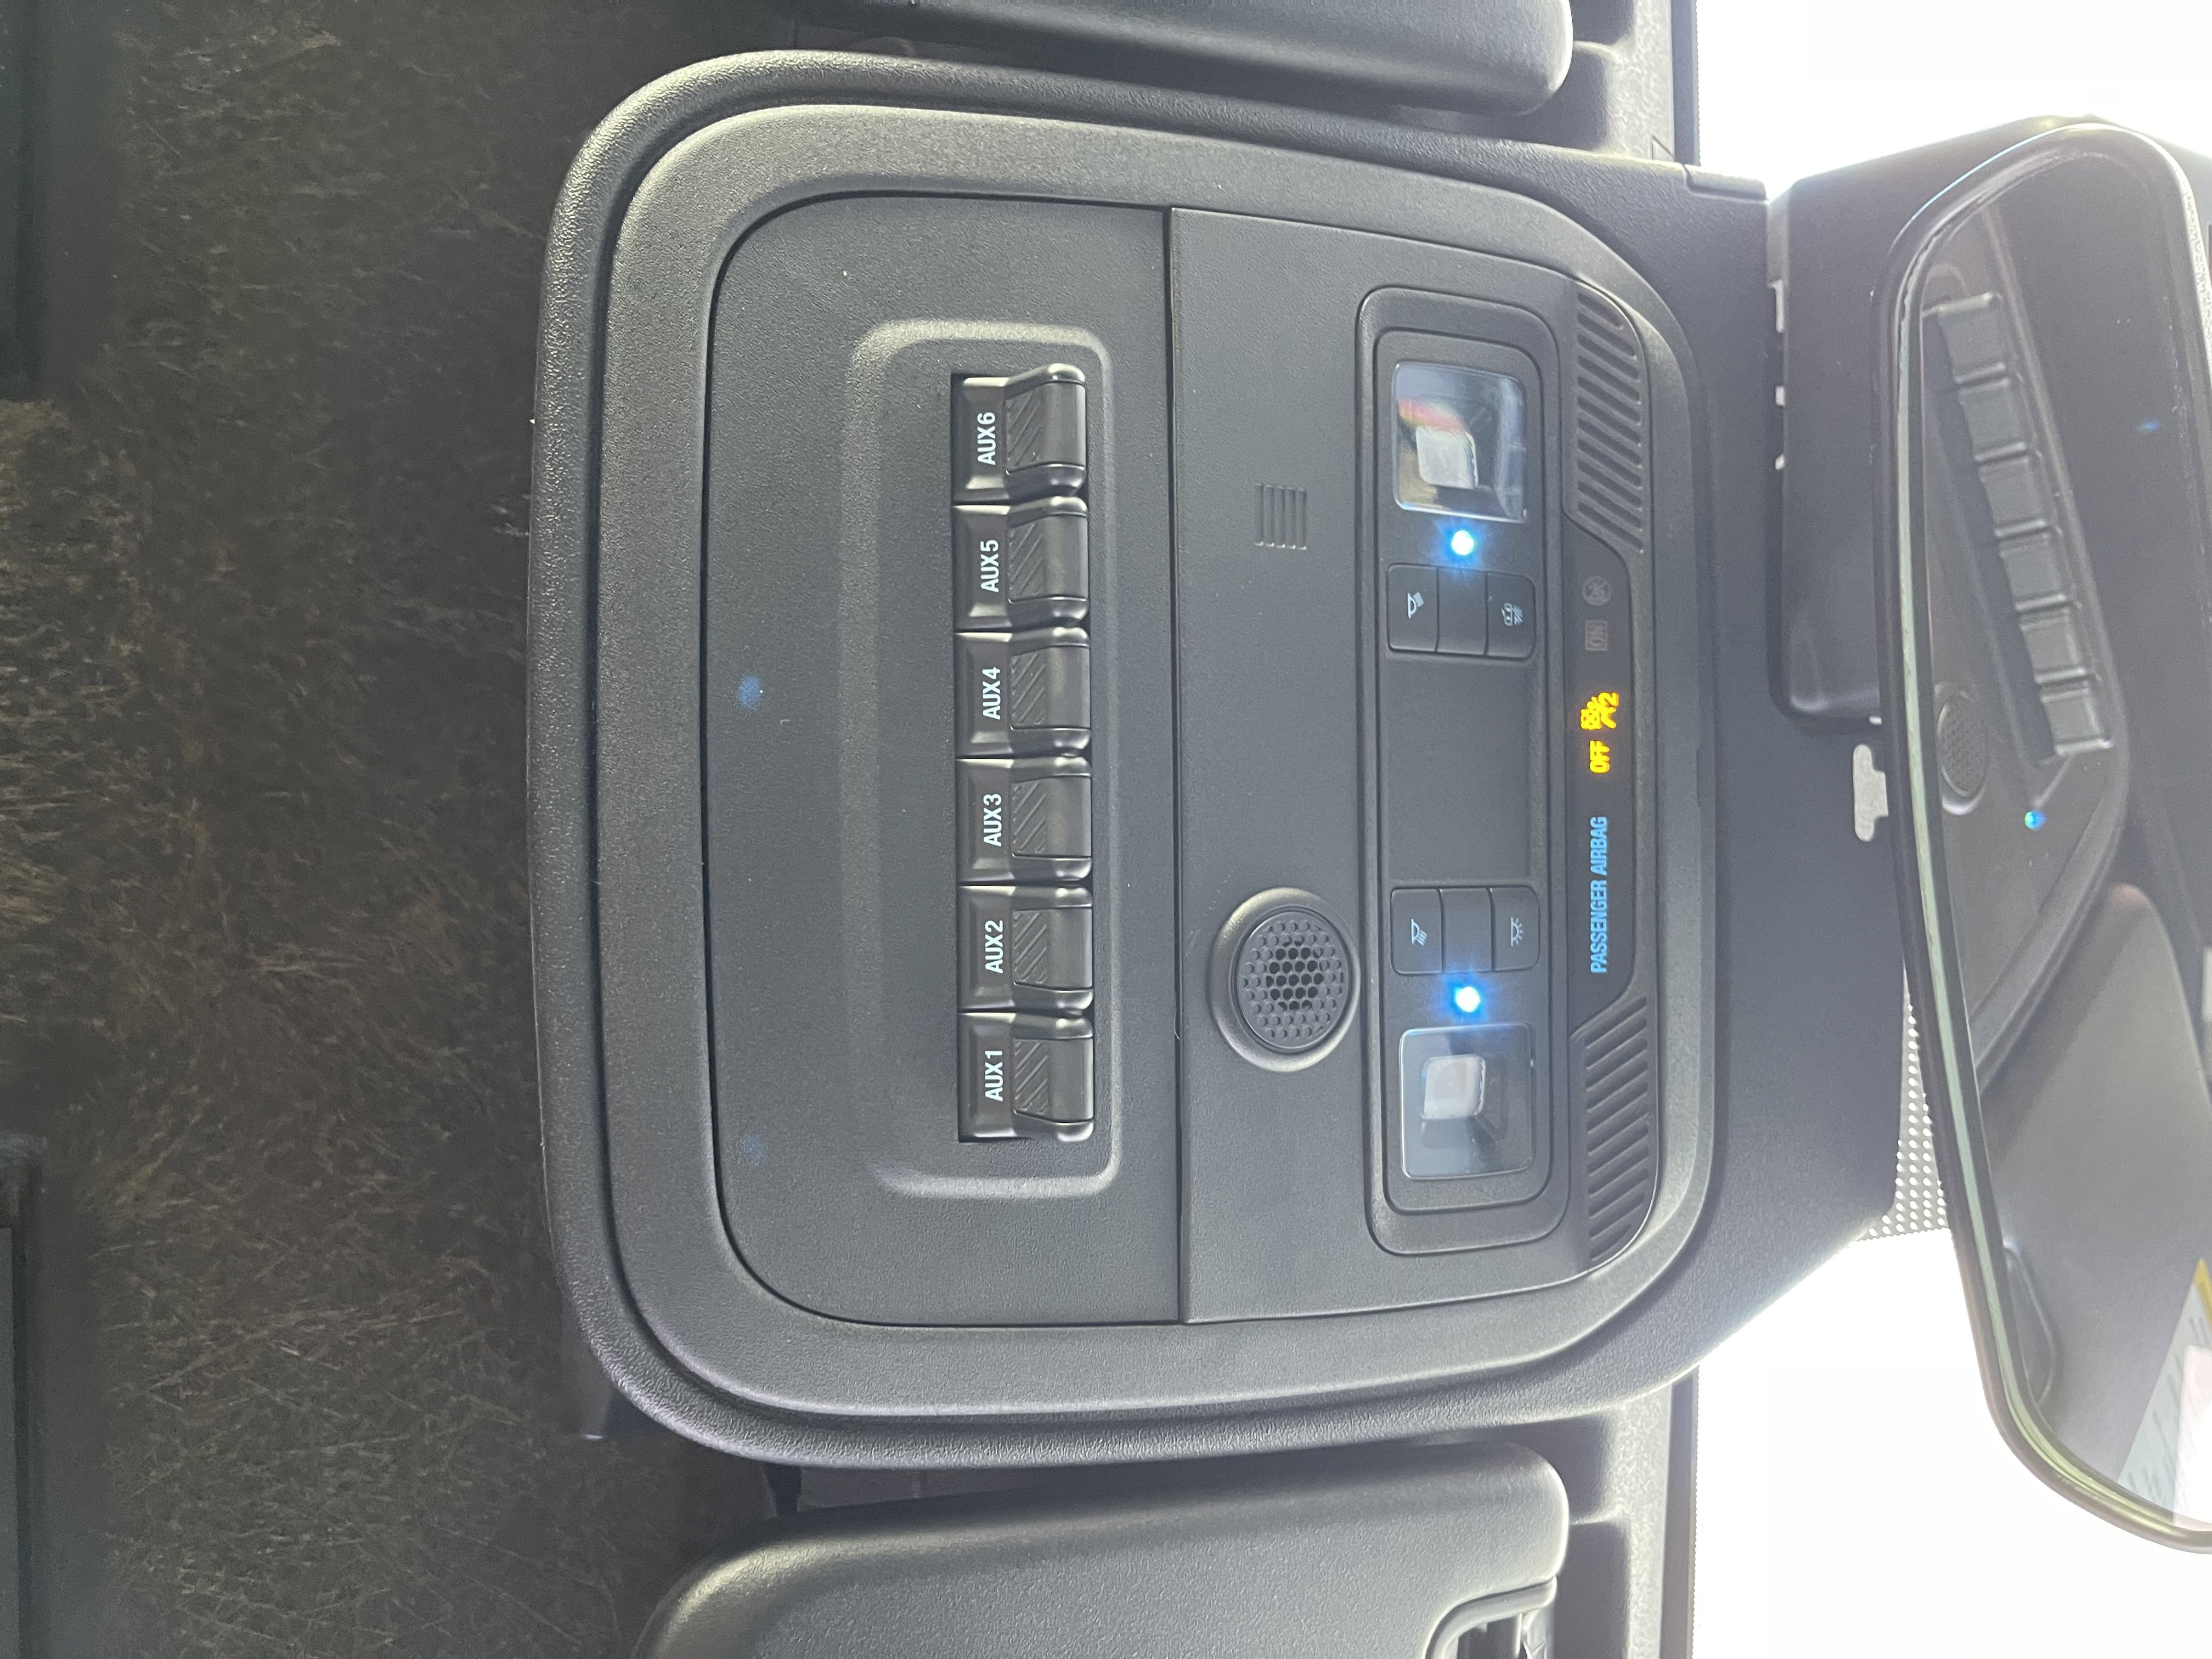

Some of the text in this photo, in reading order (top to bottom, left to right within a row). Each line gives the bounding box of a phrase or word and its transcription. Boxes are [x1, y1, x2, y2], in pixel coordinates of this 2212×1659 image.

[977, 411, 996, 466] AUX6
[980, 539, 1000, 593] AUX5
[981, 667, 1001, 720] AUX4
[1589, 740, 1610, 774] OFF
[983, 793, 1002, 847] AUX3
[1590, 816, 1607, 973] PASSENGER AIRBAG
[984, 920, 1003, 974] AUX2
[984, 1050, 1003, 1102] AUX1
